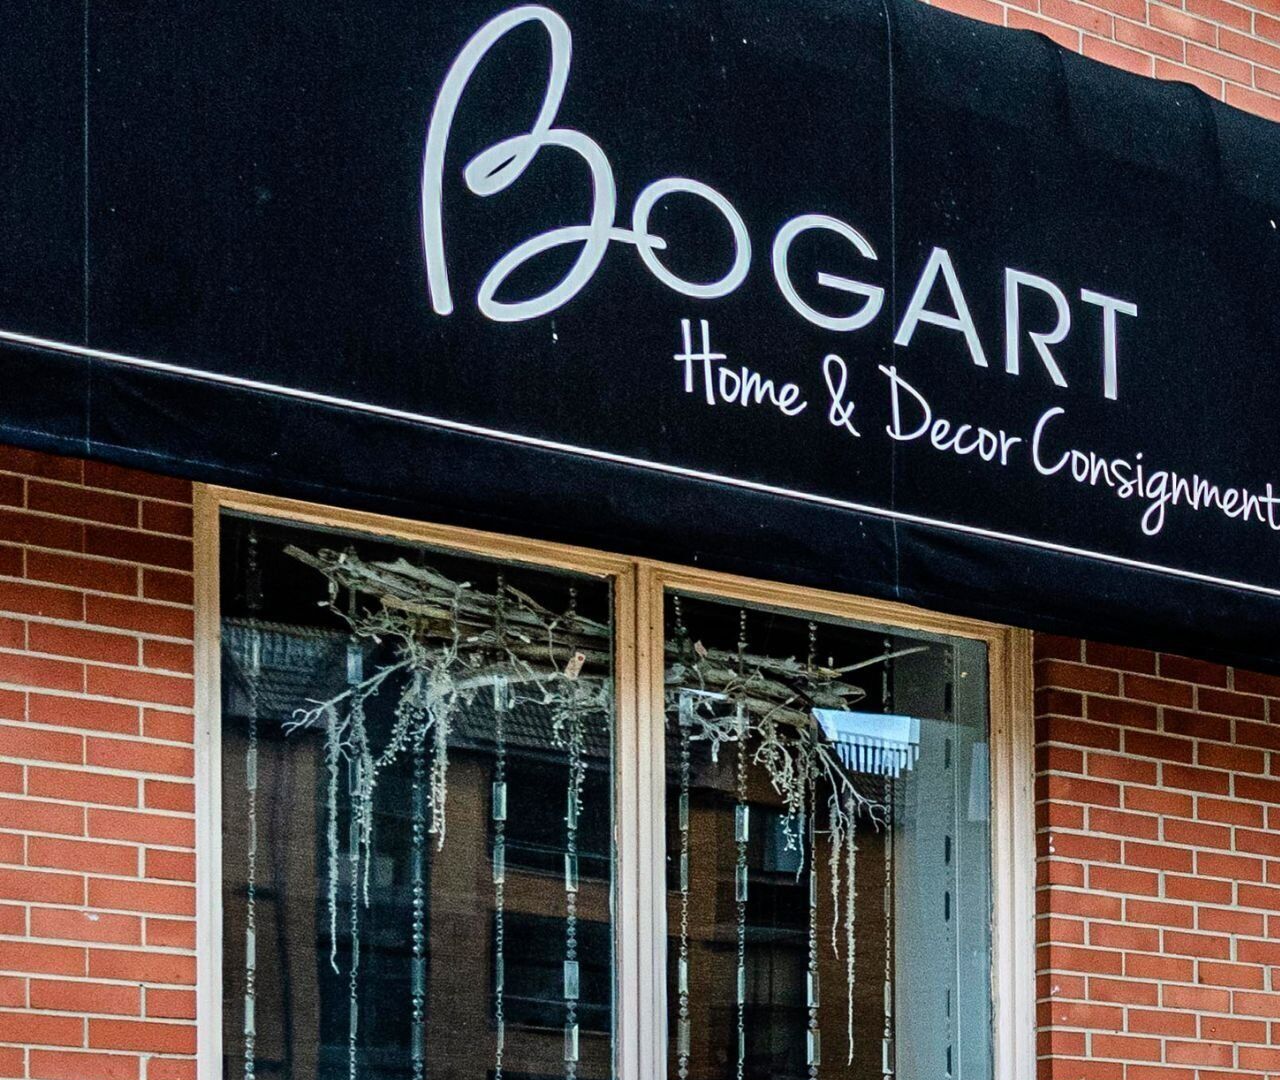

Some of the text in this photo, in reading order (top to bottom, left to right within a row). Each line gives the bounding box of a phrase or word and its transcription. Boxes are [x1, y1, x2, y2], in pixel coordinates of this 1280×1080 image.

[421, 4, 1138, 401] BOGART
[673, 318, 808, 416] Home
[822, 353, 861, 438] &
[878, 364, 1022, 466] Decor
